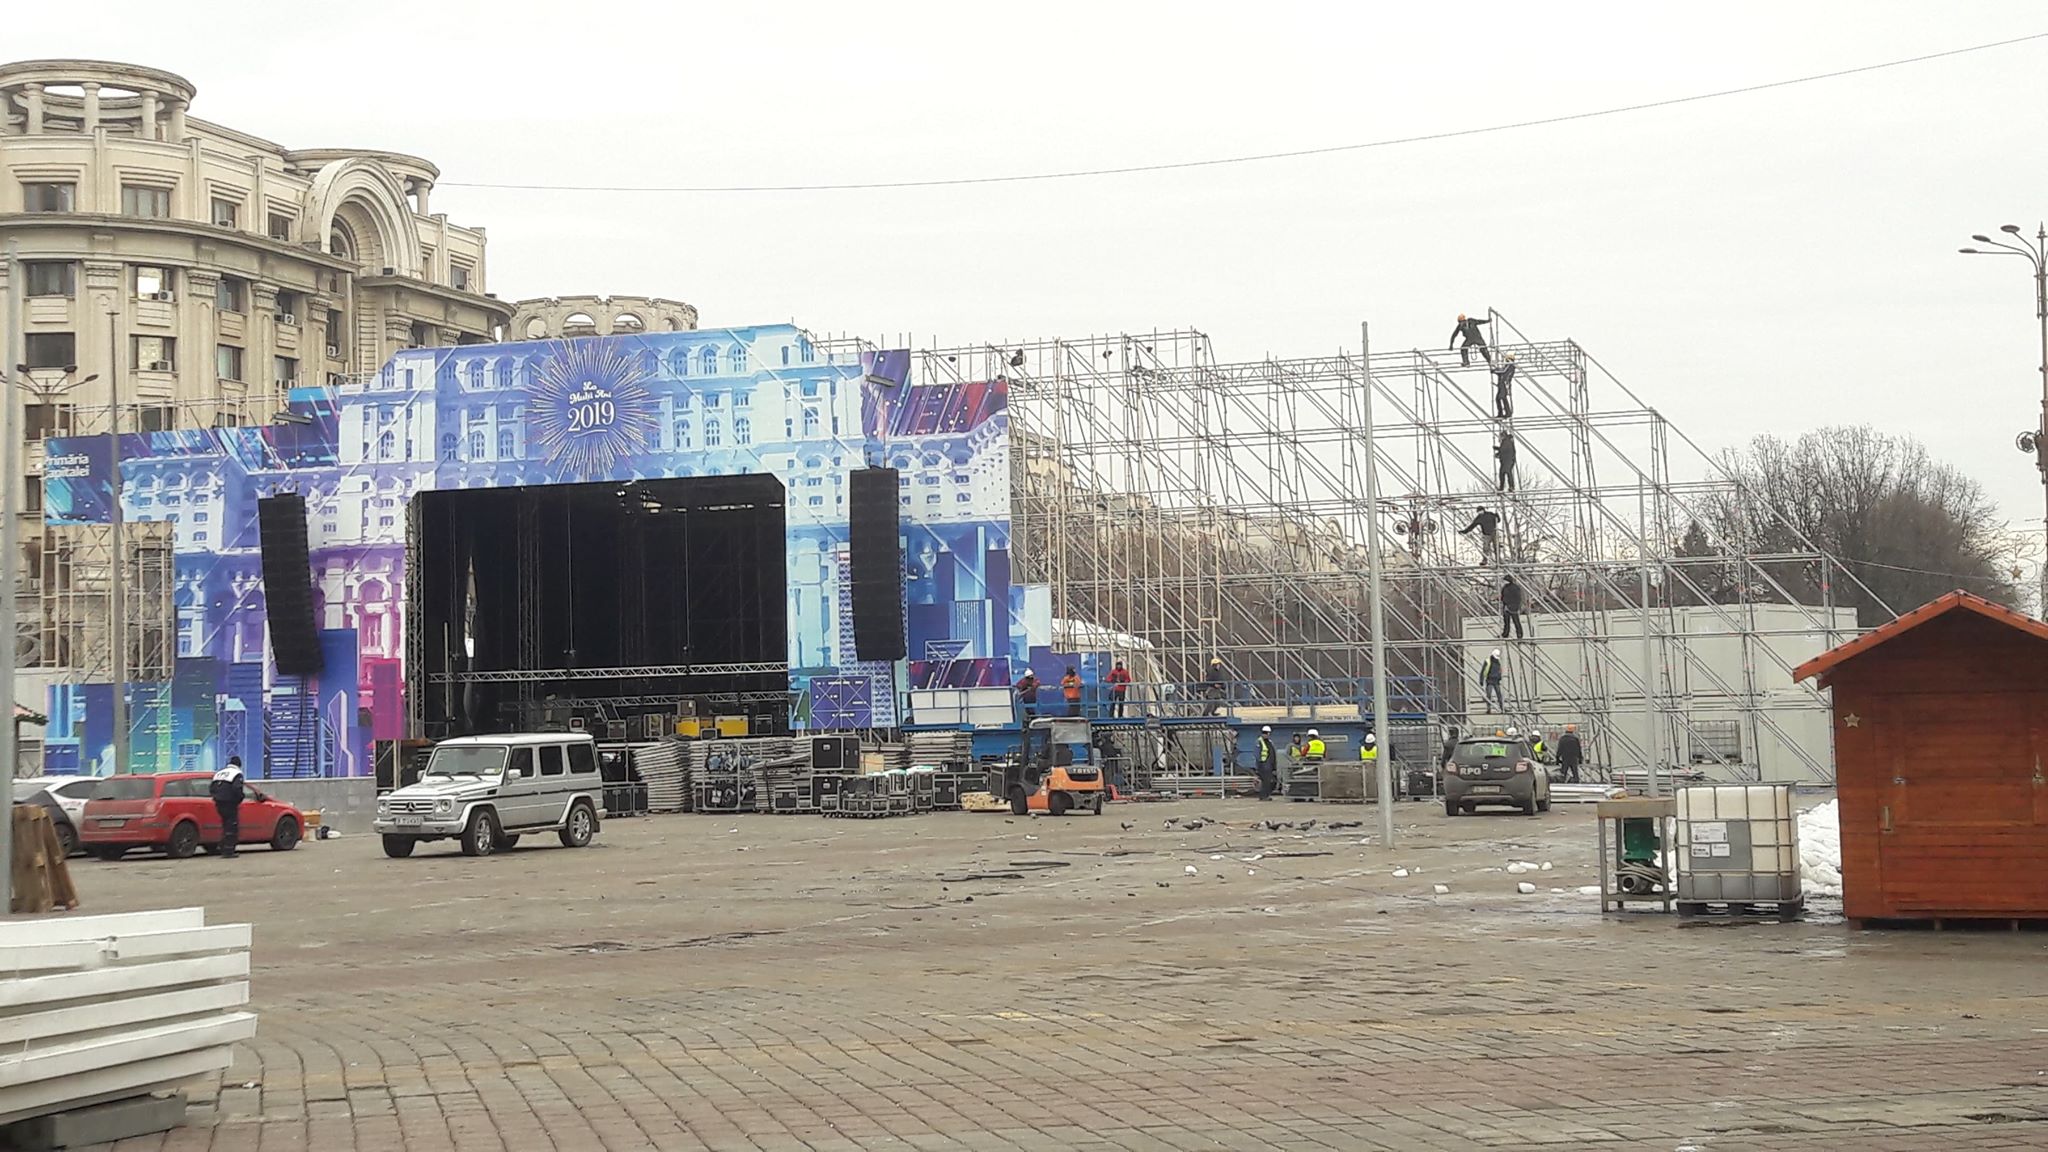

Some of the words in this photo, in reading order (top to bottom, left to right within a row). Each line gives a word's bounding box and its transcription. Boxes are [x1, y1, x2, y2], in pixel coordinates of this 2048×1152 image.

[583, 380, 597, 391] La
[594, 389, 612, 399] Ani
[567, 400, 615, 432] 2019
[1459, 767, 1482, 775] RPG
